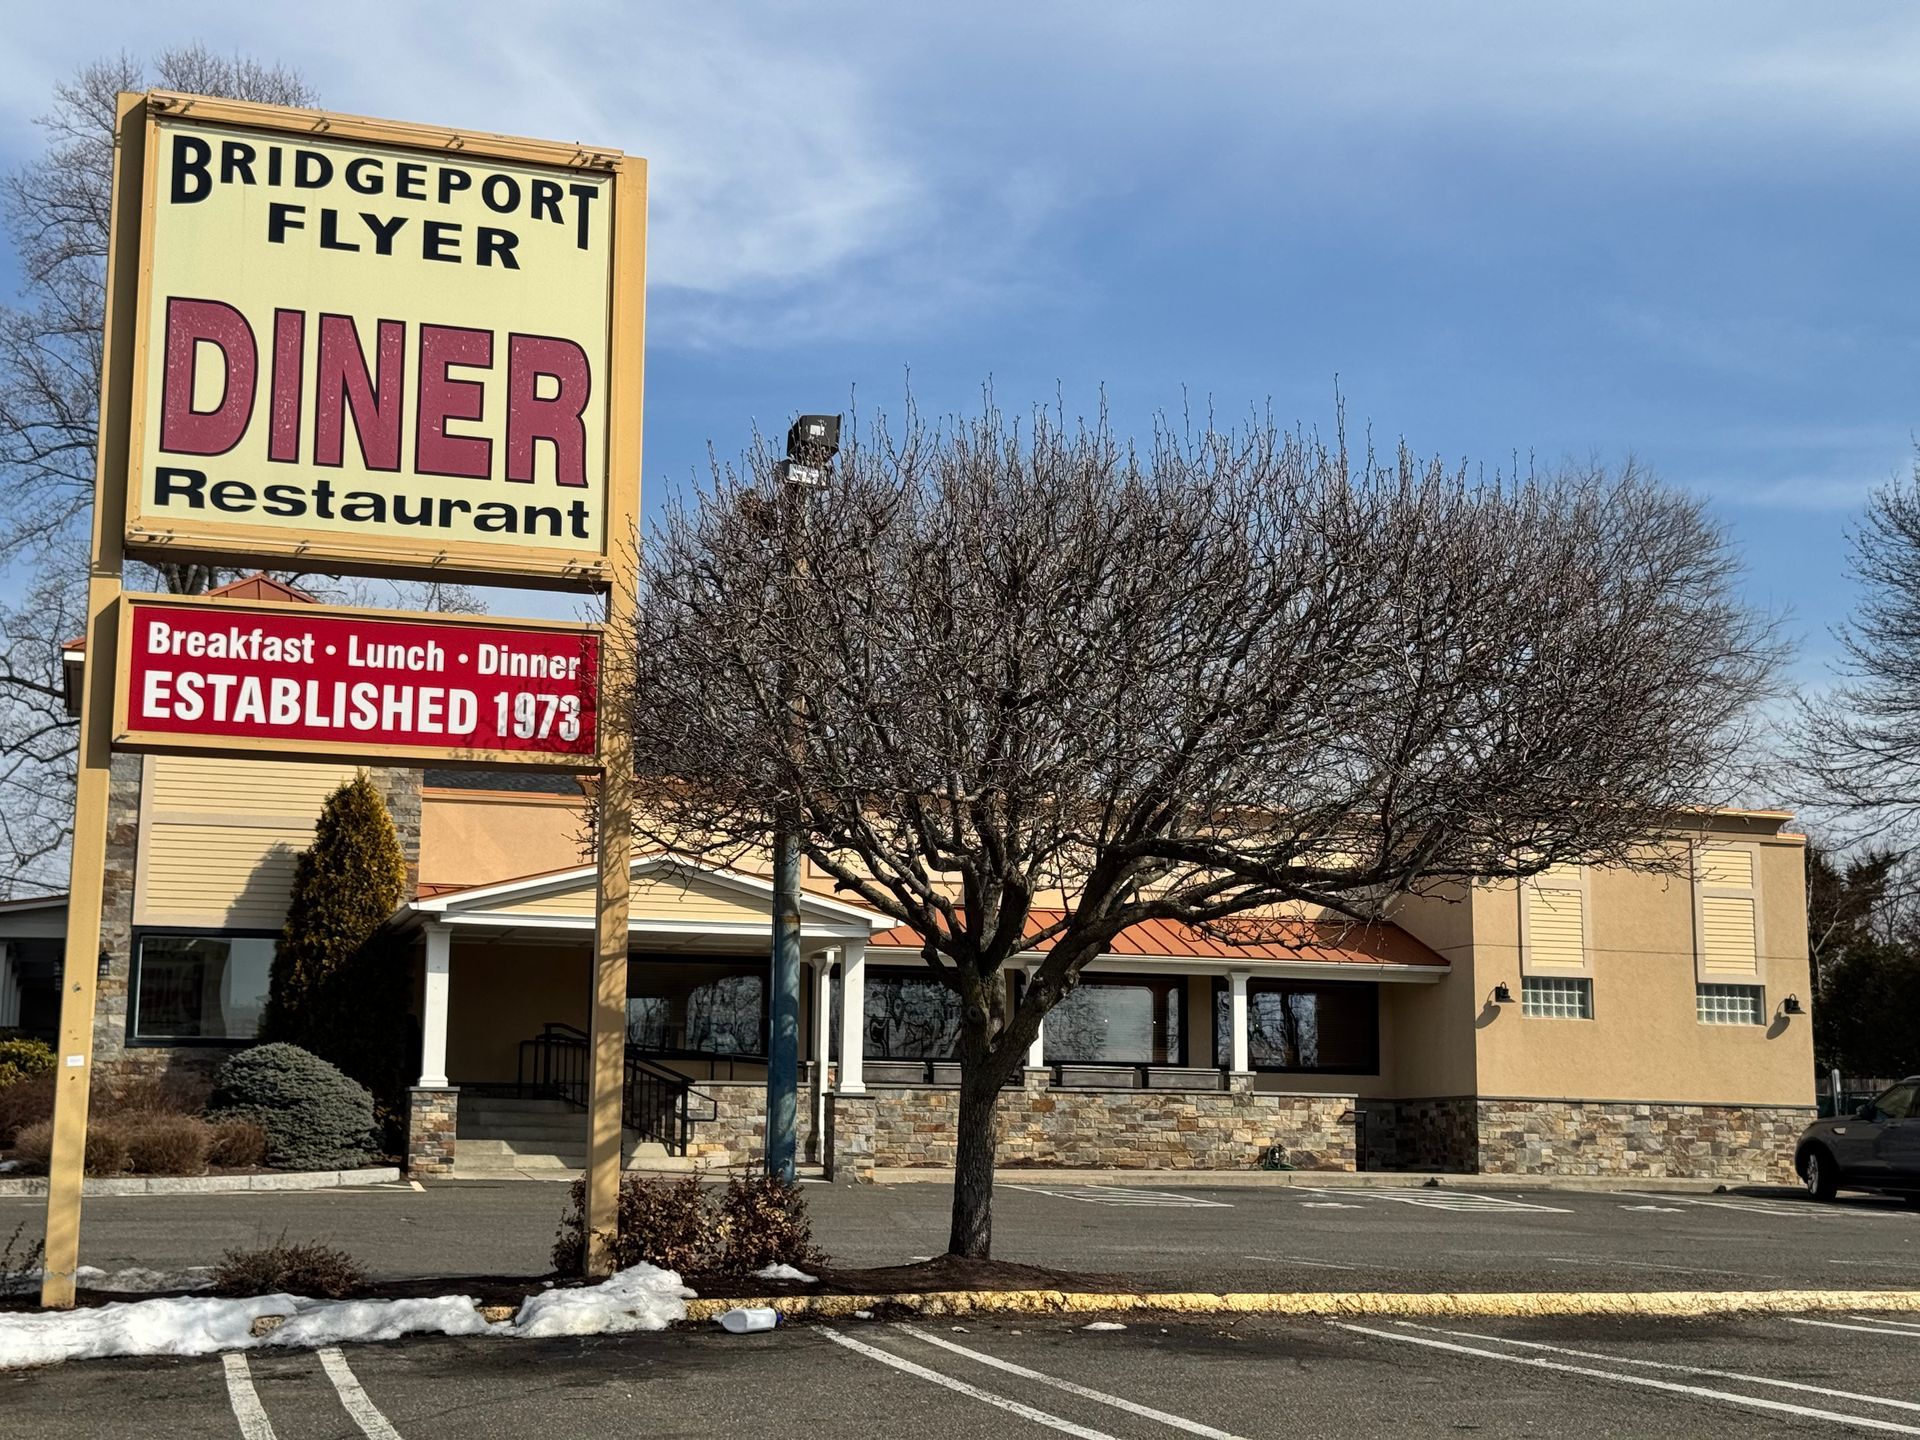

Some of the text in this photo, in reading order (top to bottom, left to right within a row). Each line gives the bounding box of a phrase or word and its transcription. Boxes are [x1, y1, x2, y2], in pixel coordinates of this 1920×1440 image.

[170, 134, 599, 251] BRIDGEPORT
[268, 203, 521, 270] FLYER
[159, 296, 592, 489] DINER
[154, 467, 590, 539] Restaurant
[147, 621, 581, 680] Breakfast Lunch Dinner
[142, 670, 582, 742] ESTABLISHED 1973
